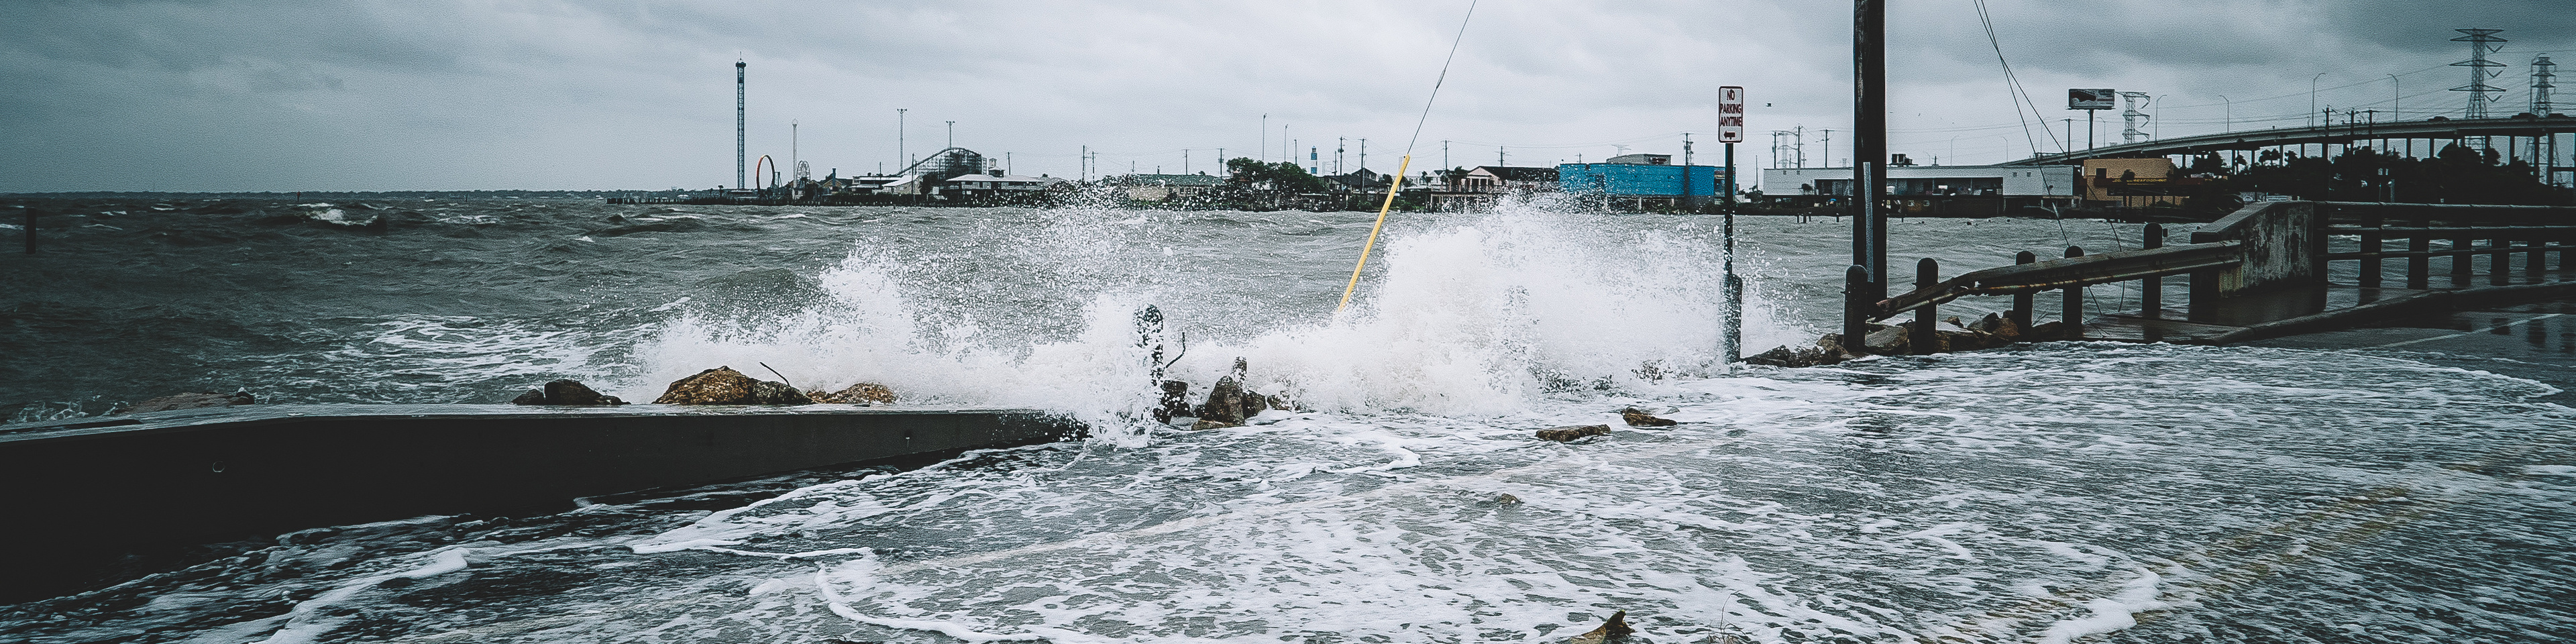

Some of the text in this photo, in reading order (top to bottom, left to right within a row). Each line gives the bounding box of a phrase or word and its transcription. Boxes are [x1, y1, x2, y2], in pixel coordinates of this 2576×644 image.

[1727, 90, 1735, 101] NO
[1720, 103, 1741, 113] PARKING
[1720, 117, 1741, 126] ANYTIME
